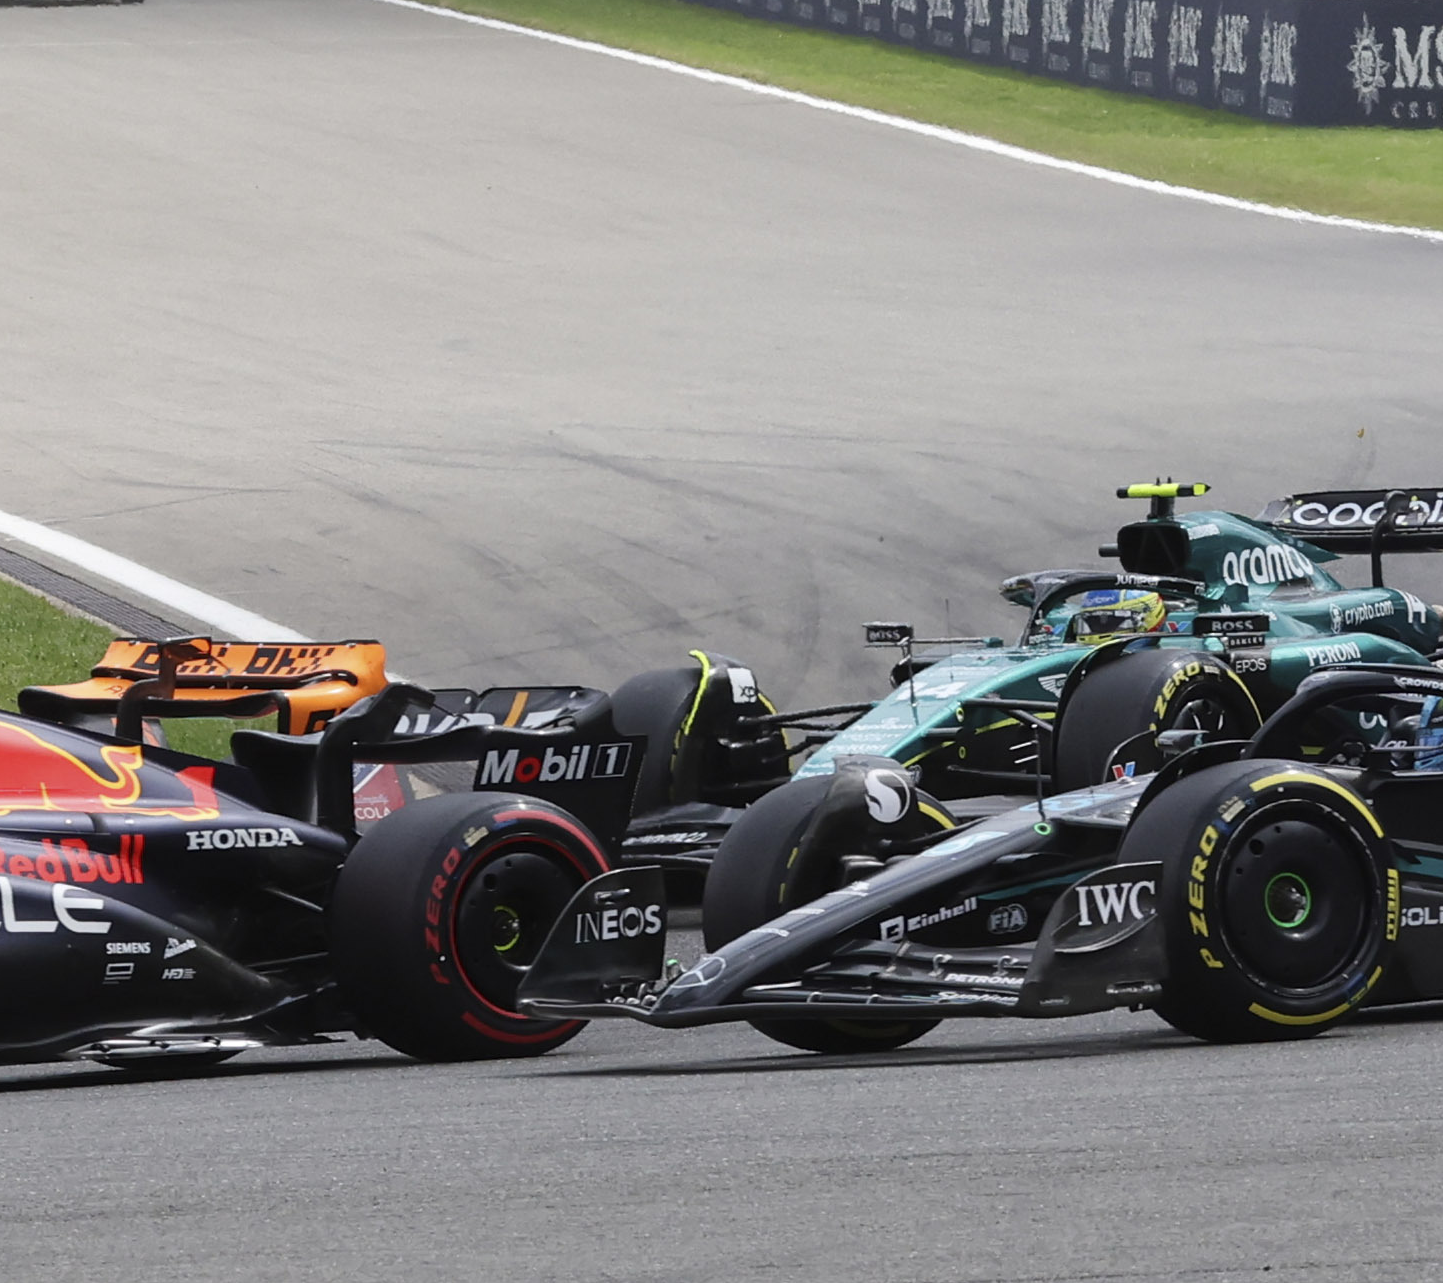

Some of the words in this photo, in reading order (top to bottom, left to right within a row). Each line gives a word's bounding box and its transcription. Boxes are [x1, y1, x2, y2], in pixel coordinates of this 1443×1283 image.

[1223, 543, 1315, 585] aramco
[1212, 620, 1254, 631] BOSS
[1345, 600, 1394, 629] crypto.com
[1236, 657, 1267, 674] EPOS
[1303, 641, 1361, 666] PERONI
[1154, 660, 1202, 719] ZERO
[480, 745, 589, 785] Mobil
[186, 827, 304, 852] HONDA
[59, 833, 145, 885] Bull
[1188, 825, 1220, 938] ZERO
[424, 846, 462, 953] ZERO
[907, 896, 978, 931] Einhell
[1075, 879, 1157, 927] IWC
[574, 904, 662, 944] INEOS
[106, 942, 151, 955] SIEMENS
[1200, 948, 1224, 968] P
[944, 973, 1025, 985] PETRONA
